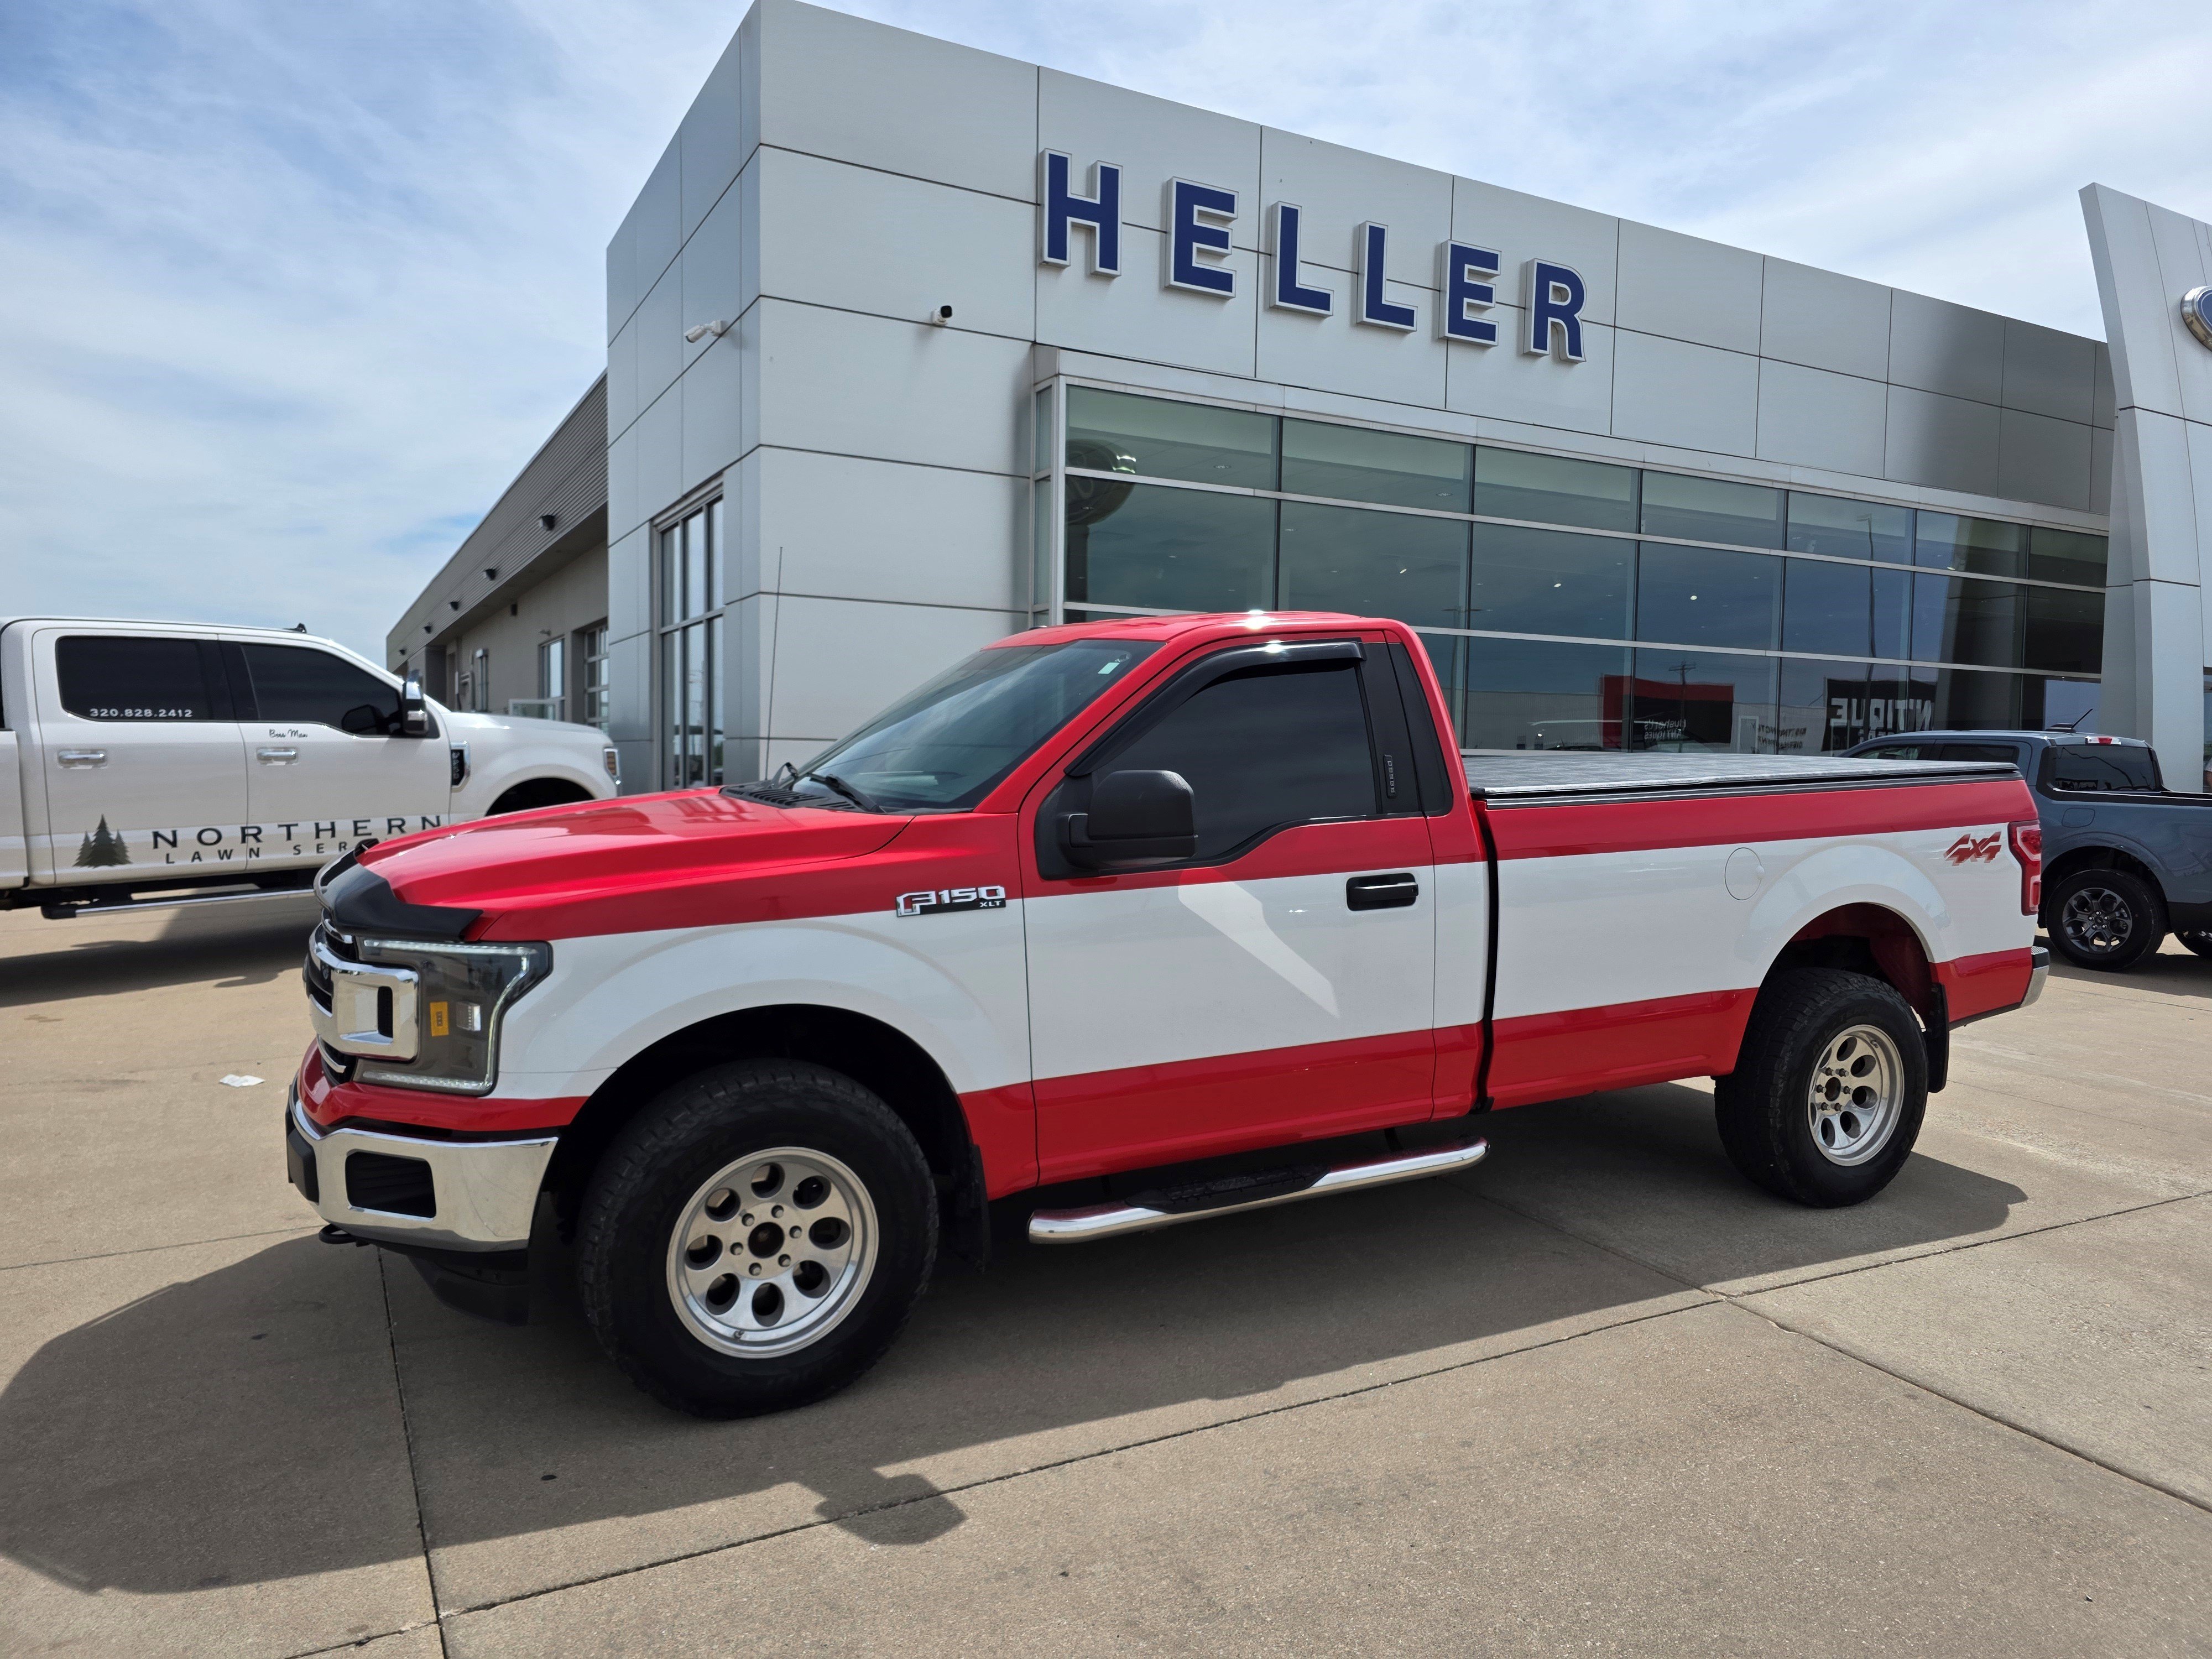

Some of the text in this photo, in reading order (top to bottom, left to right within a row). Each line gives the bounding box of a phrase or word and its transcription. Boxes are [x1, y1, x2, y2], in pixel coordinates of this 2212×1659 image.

[1040, 148, 1586, 363] HELLER
[90, 708, 193, 717] 320.828.2412
[288, 729, 308, 738] Man
[152, 815, 442, 849] NORTHERN
[165, 841, 347, 864] LAWN SER
